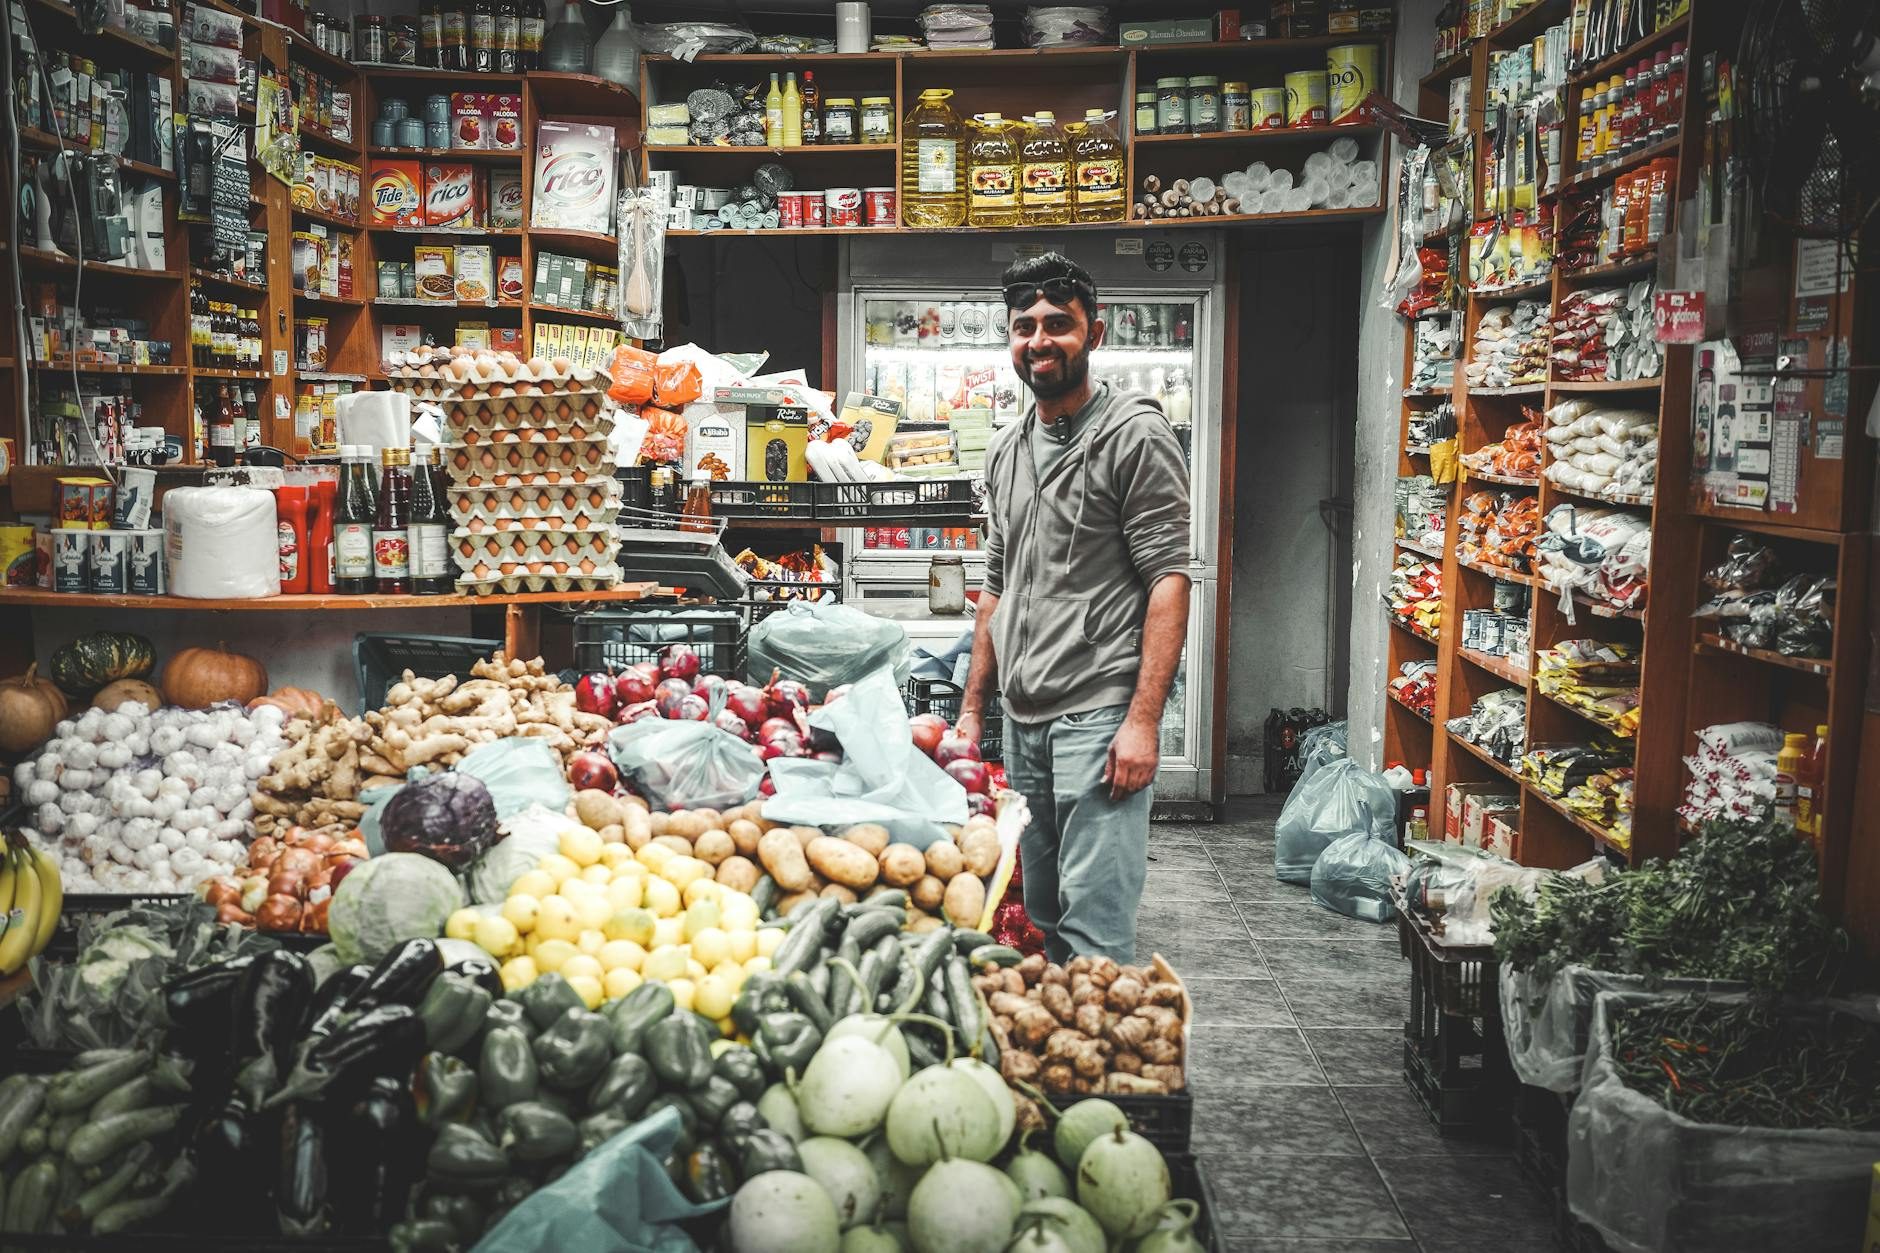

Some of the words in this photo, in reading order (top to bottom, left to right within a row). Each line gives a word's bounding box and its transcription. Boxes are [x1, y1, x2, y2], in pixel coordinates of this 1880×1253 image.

[1329, 72, 1354, 85] DO
[545, 165, 602, 193] rico
[376, 188, 402, 206] Tide
[430, 184, 468, 204] rico
[967, 369, 995, 388] TWIST
